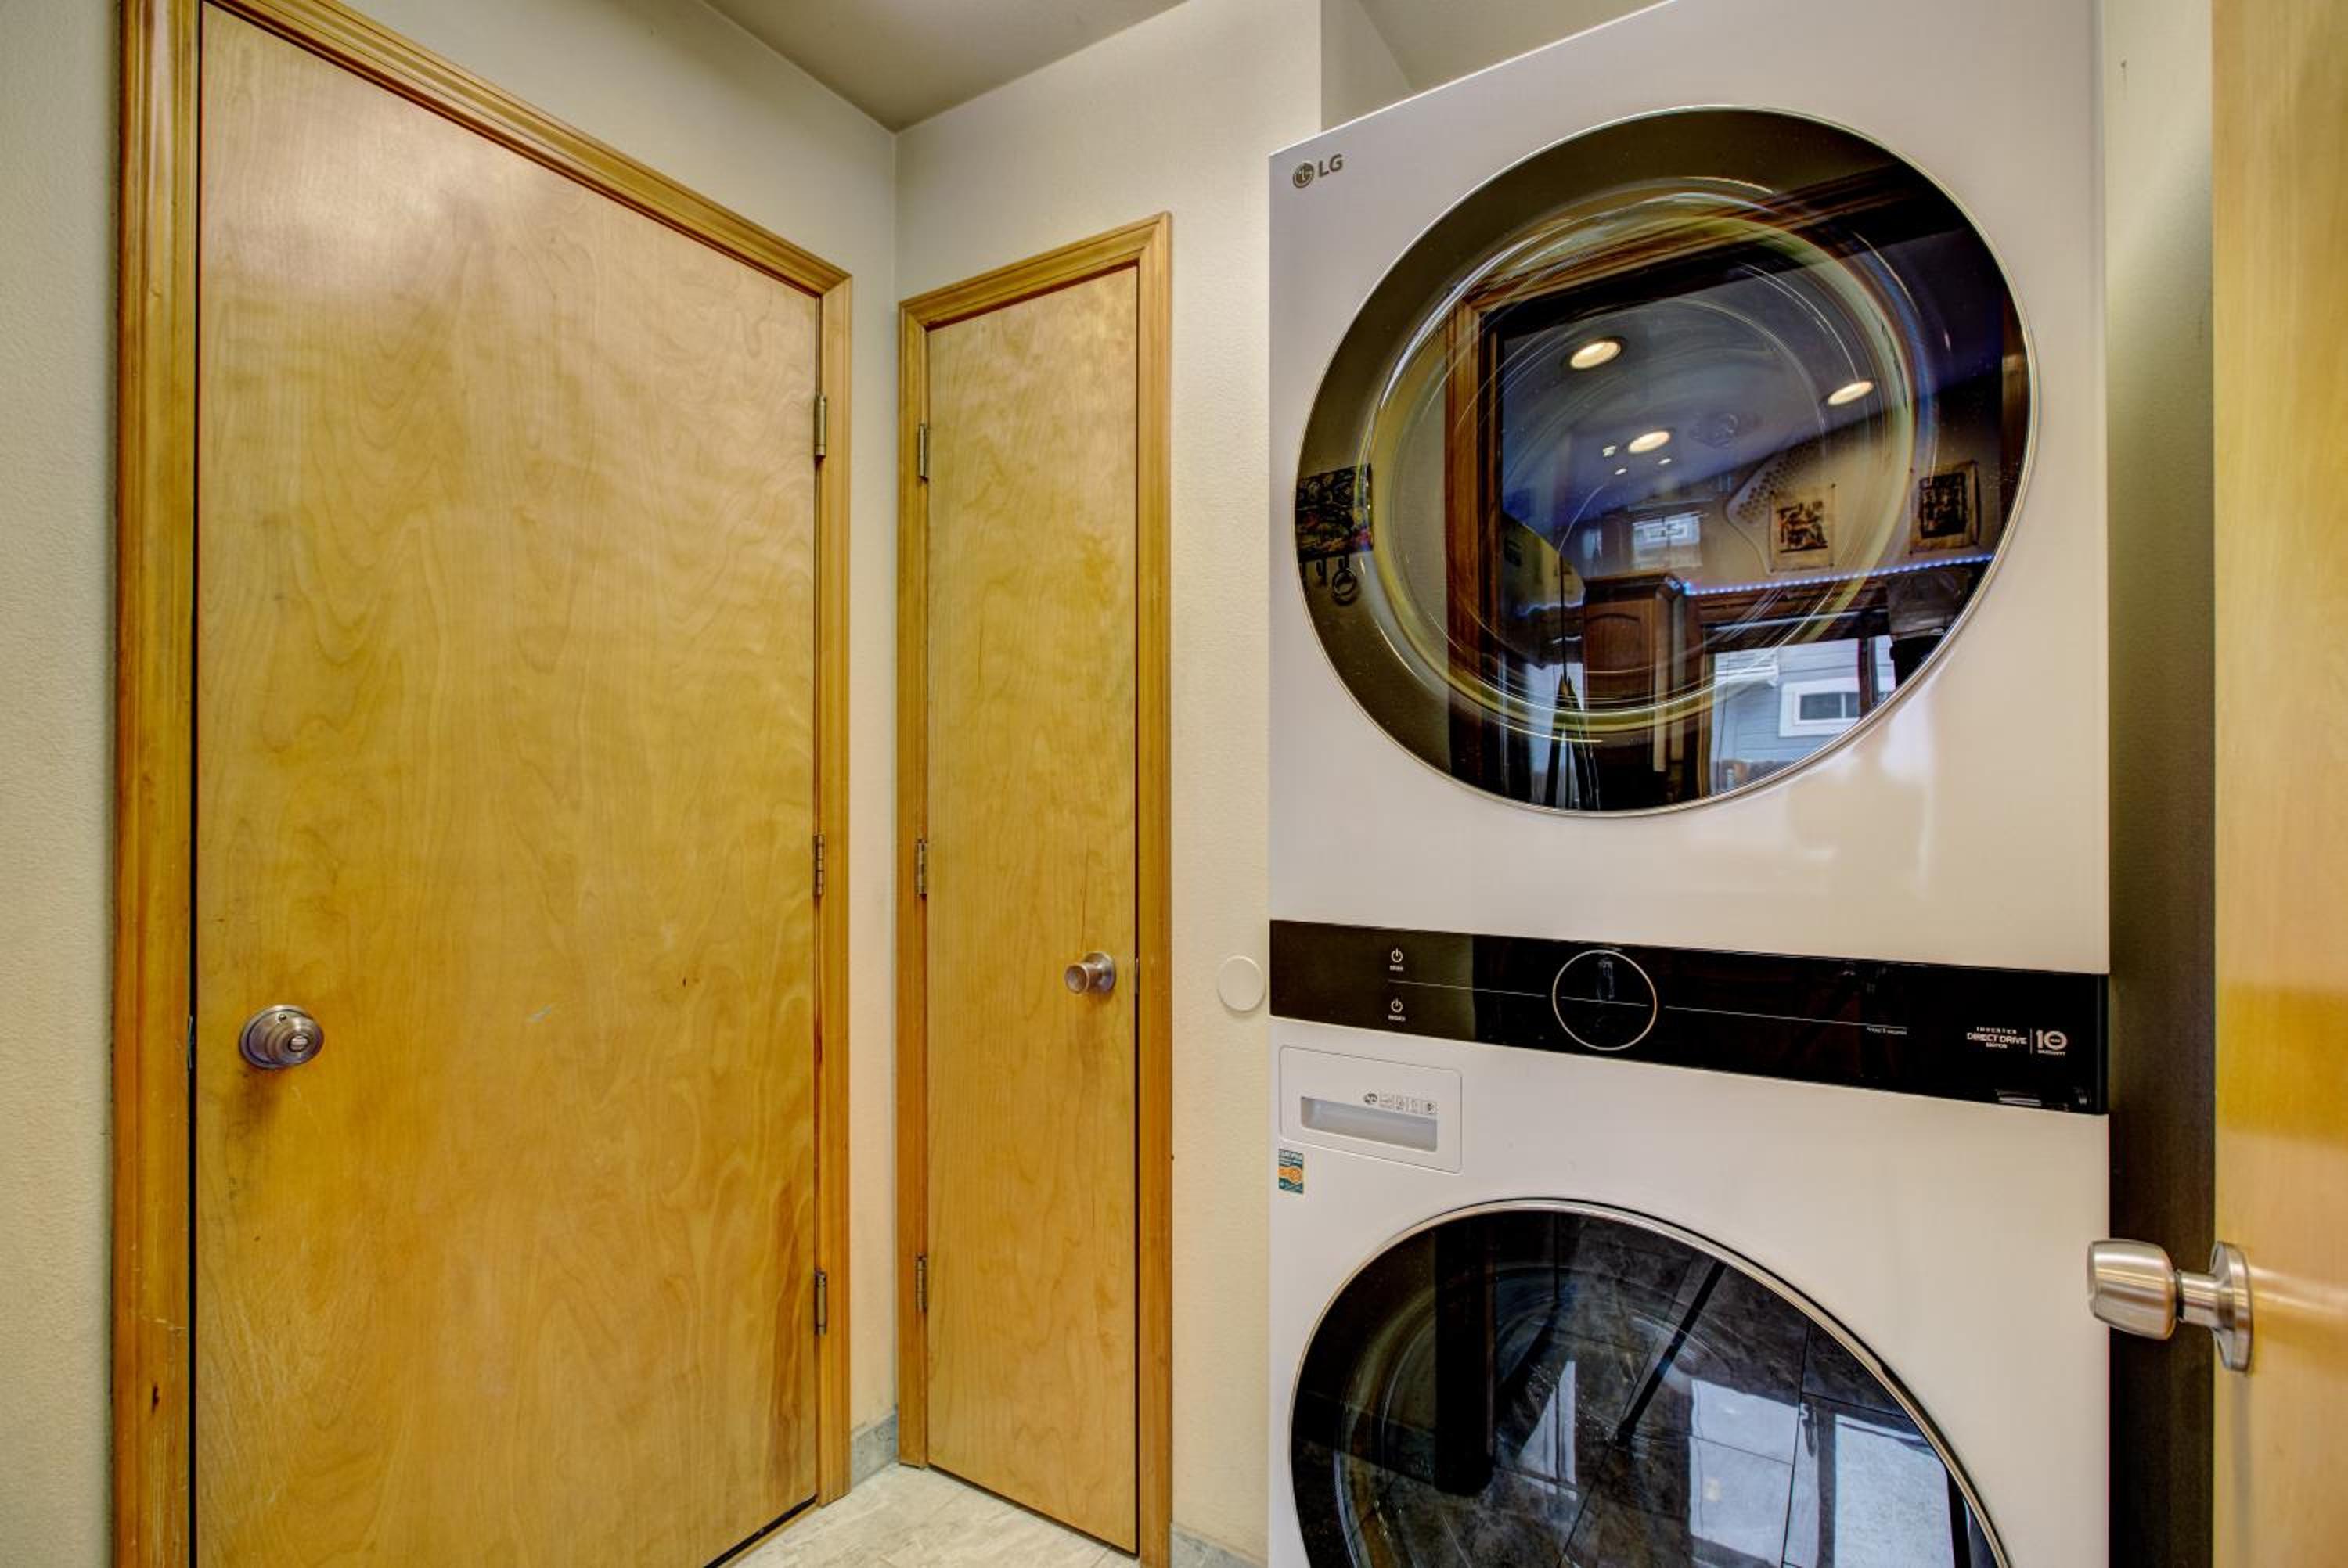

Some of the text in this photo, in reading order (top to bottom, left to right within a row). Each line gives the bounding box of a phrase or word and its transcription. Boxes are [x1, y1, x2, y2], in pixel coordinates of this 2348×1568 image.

[1318, 153, 1343, 178] LG
[1966, 1032, 2027, 1045] DIRECT DRIVE
